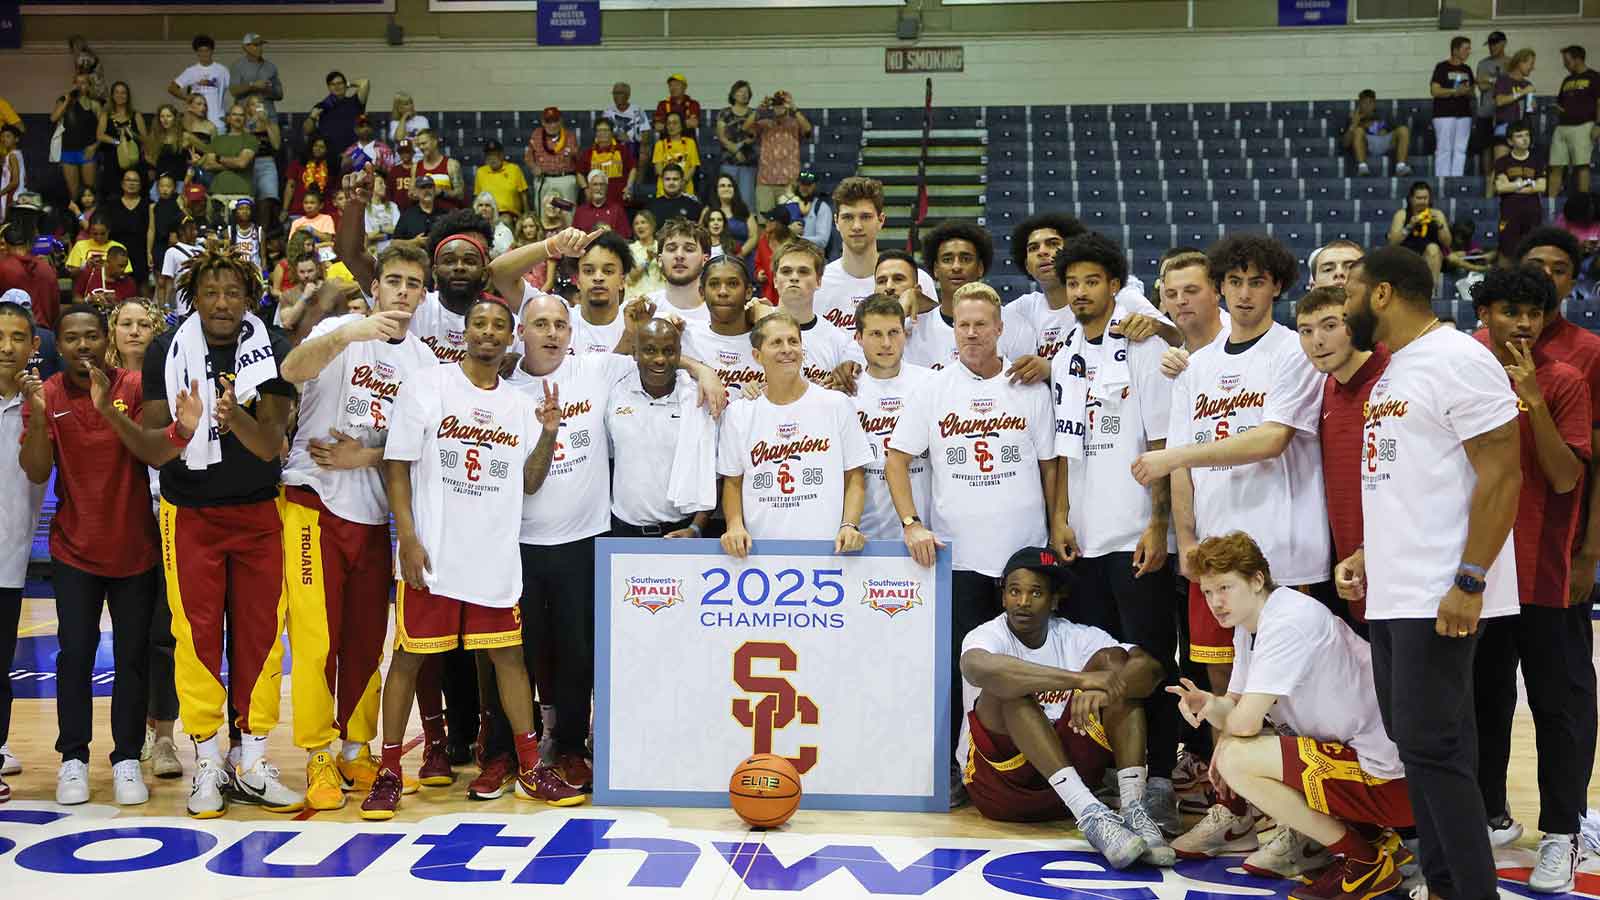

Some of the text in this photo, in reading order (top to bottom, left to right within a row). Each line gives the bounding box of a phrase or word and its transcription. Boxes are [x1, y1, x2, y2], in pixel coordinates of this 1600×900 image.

[887, 48, 962, 70] NO SMOKING
[1194, 388, 1266, 420] Champions
[437, 415, 519, 447] Champions
[938, 412, 1027, 439] Champions
[1101, 416, 1120, 434] 25
[570, 430, 591, 448] 25
[1379, 438, 1397, 461] 25
[751, 435, 830, 467] Champions
[946, 445, 1021, 465] 20 25
[974, 440, 993, 472] SC
[465, 449, 481, 481] SC
[489, 459, 508, 479] 25
[442, 477, 467, 488] NIVERSITY
[753, 467, 824, 489] 20 25
[777, 463, 795, 494] SC
[301, 525, 312, 585] TROJANS
[630, 576, 671, 584] Southwest
[631, 585, 676, 596] MAUI
[700, 568, 845, 607] 2025
[868, 579, 909, 587] Southwest
[869, 588, 915, 599] MAUI
[700, 611, 845, 629] CHAMPIONS
[732, 641, 819, 775] SC
[741, 775, 779, 788] ELITE
